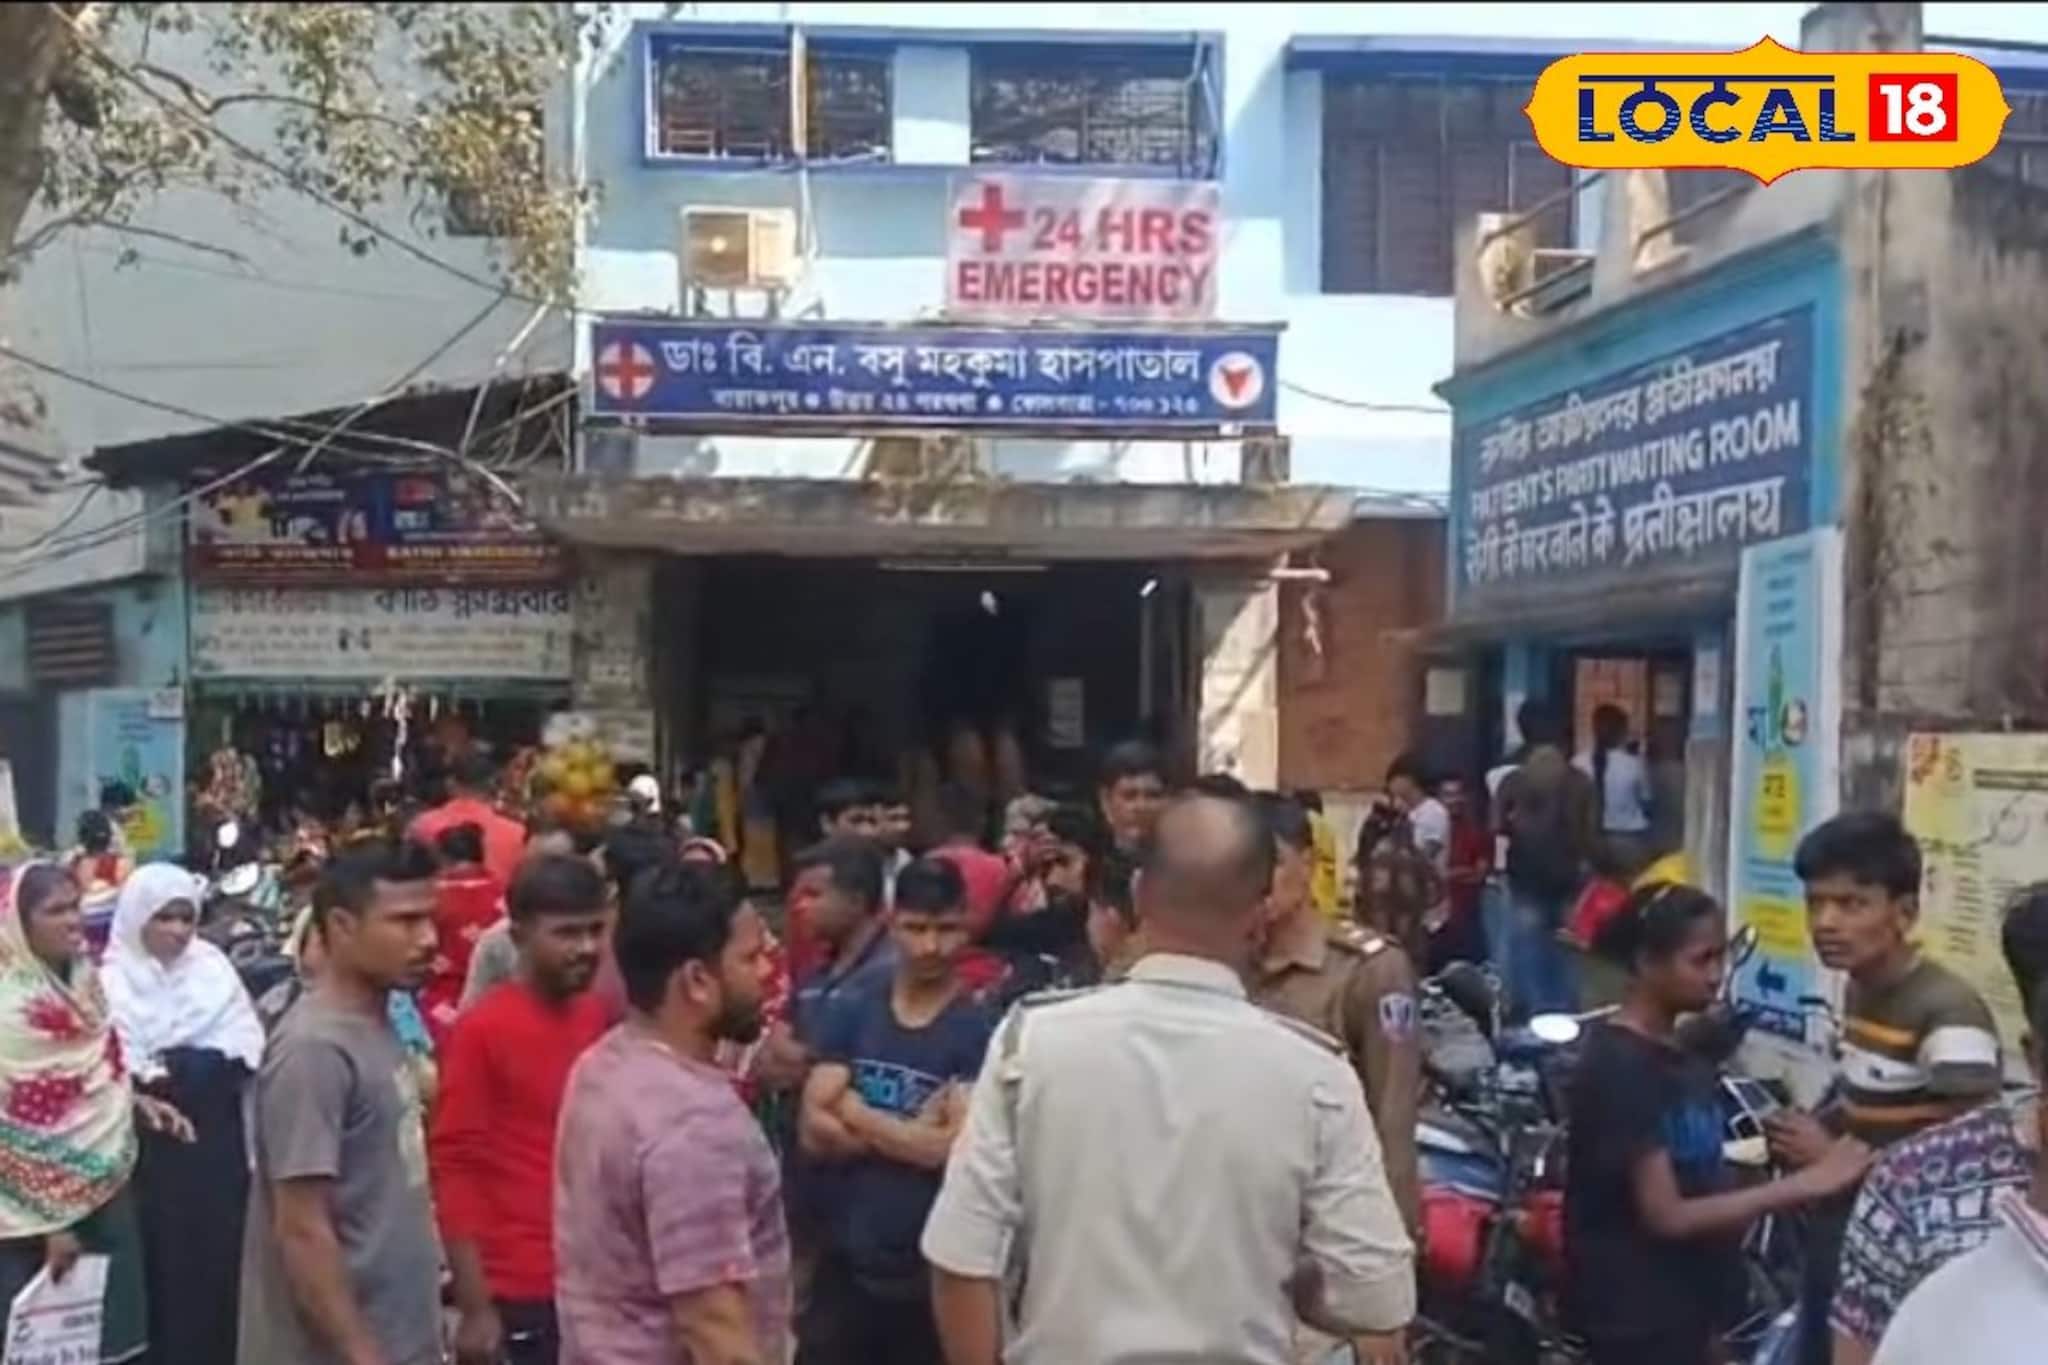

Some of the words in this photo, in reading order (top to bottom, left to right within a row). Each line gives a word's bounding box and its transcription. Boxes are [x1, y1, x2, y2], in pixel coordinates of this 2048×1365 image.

[1031, 206, 1082, 250] 24
[1096, 205, 1212, 254] HRS
[958, 260, 1209, 306] EMERGENCY
[660, 340, 717, 373] ডাঃ
[726, 331, 773, 376] বি.
[784, 344, 846, 375] এন.
[853, 344, 912, 388] বসু
[916, 345, 1027, 388] মহকুমা
[1033, 345, 1200, 382] হাসপাতাল
[1609, 430, 1706, 489] WAITING
[1709, 400, 1801, 464] ROOM
